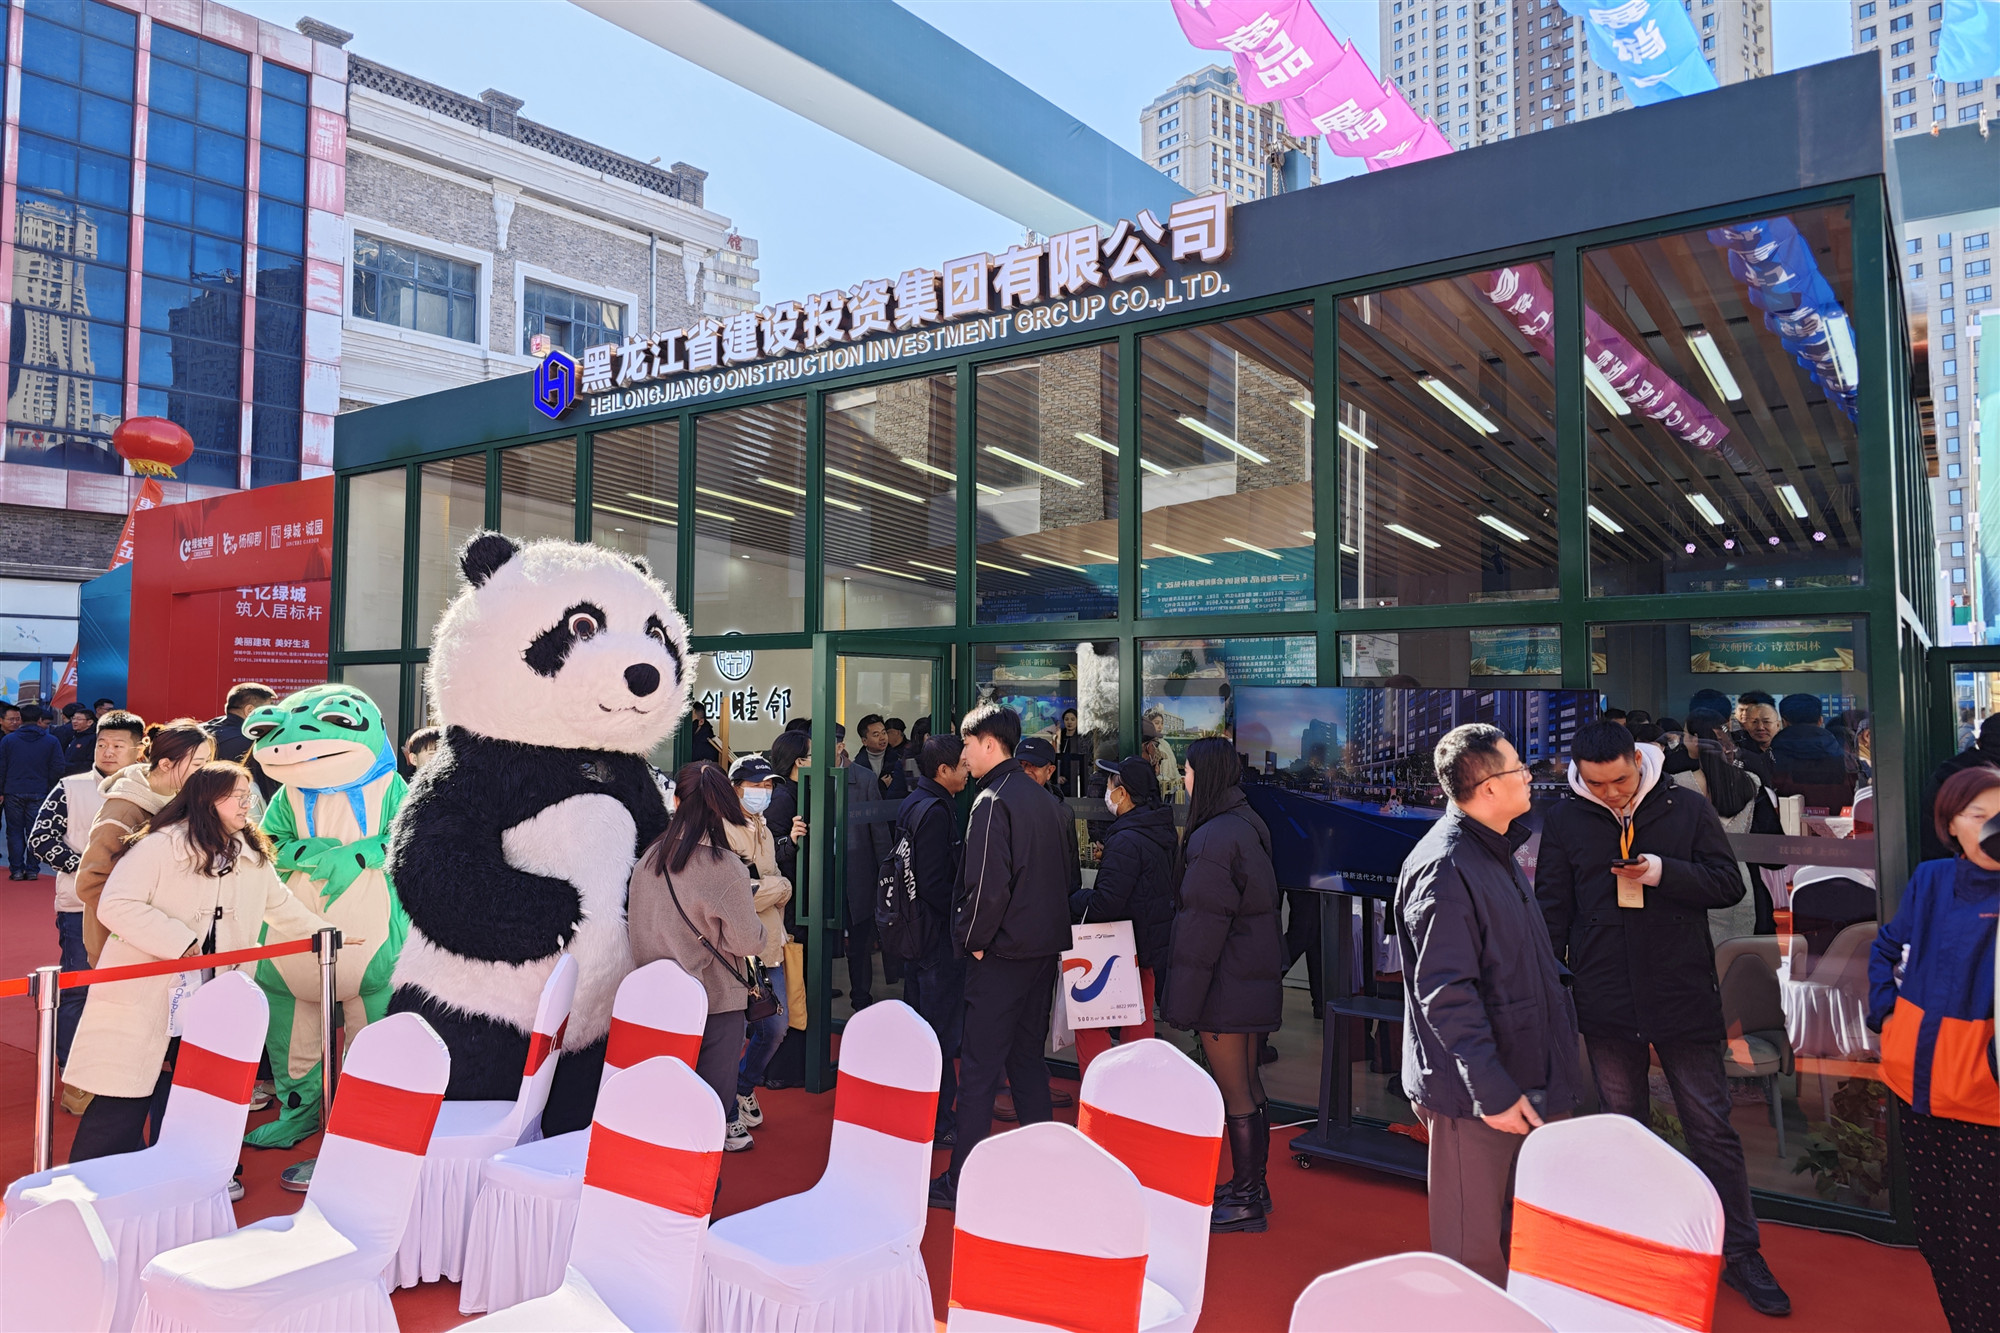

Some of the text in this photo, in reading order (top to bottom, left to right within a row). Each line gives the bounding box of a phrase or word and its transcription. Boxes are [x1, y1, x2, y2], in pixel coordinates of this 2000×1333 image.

[580, 191, 1230, 397] 黑龙江省建设投资集团有限公司
[866, 313, 1013, 363] INVESTMENT
[236, 585, 307, 602] 千亿绿城
[235, 600, 323, 621] 筑人居标杆
[234, 637, 310, 649] 美丽建筑 美好生活
